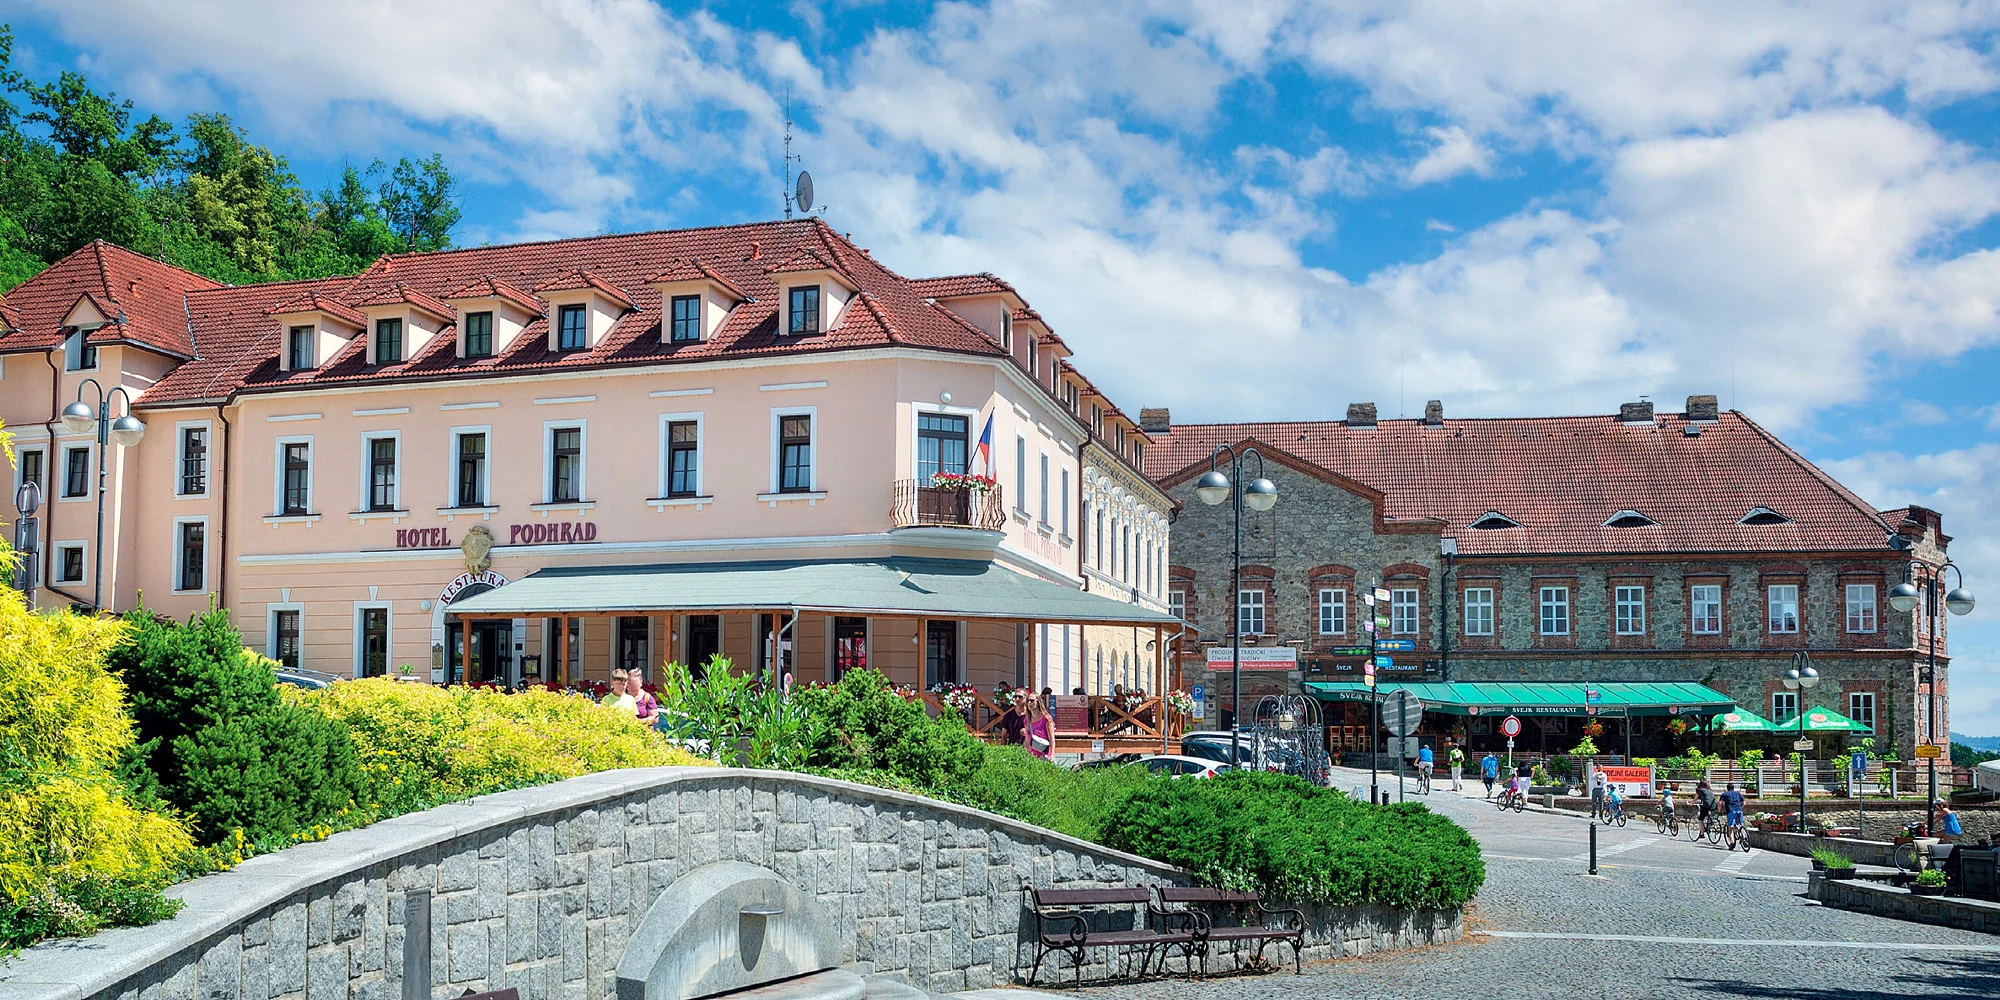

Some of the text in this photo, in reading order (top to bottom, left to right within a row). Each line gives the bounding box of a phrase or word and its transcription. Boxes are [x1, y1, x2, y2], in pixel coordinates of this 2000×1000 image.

[396, 522, 597, 547] HOTEL PODHRAD
[1336, 662, 1352, 671] ŠVEJK
[1194, 687, 1202, 697] P
